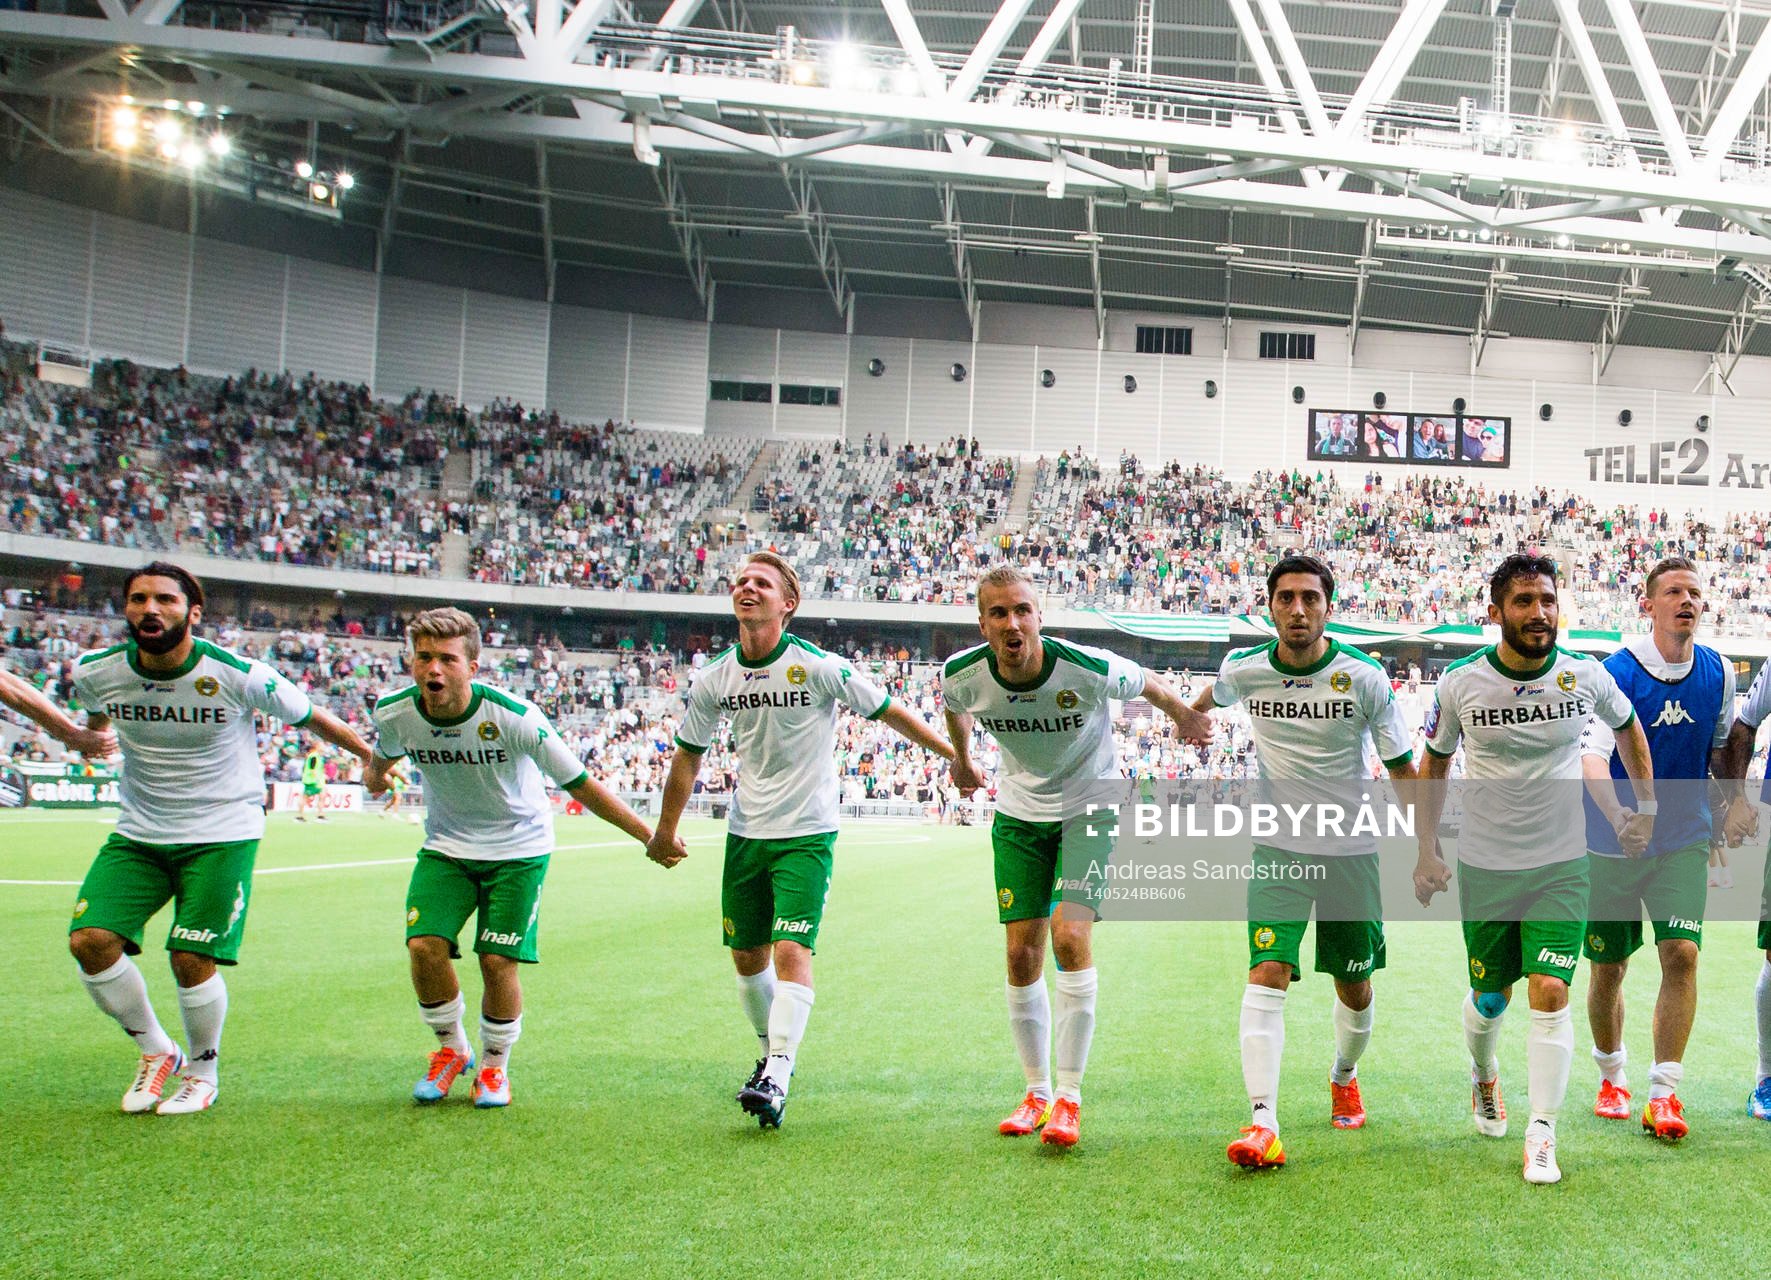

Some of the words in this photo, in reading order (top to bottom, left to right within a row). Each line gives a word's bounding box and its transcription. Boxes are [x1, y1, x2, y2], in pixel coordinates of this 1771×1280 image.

[1584, 438, 1709, 486] TELE2
[1719, 453, 1771, 489] Ar
[720, 691, 811, 711] HERBALIFE
[1249, 700, 1353, 719] HERBALIFE
[106, 703, 227, 723] HERBALIFE
[979, 713, 1084, 733] HERBALIFE
[1471, 699, 1587, 727] HERBALIFE
[404, 747, 508, 765] HERBALIFE
[97, 780, 121, 802] JÄ
[171, 924, 218, 943] Inair
[774, 917, 813, 934] Inair
[480, 928, 522, 946] Inair
[1537, 947, 1577, 969] Inair
